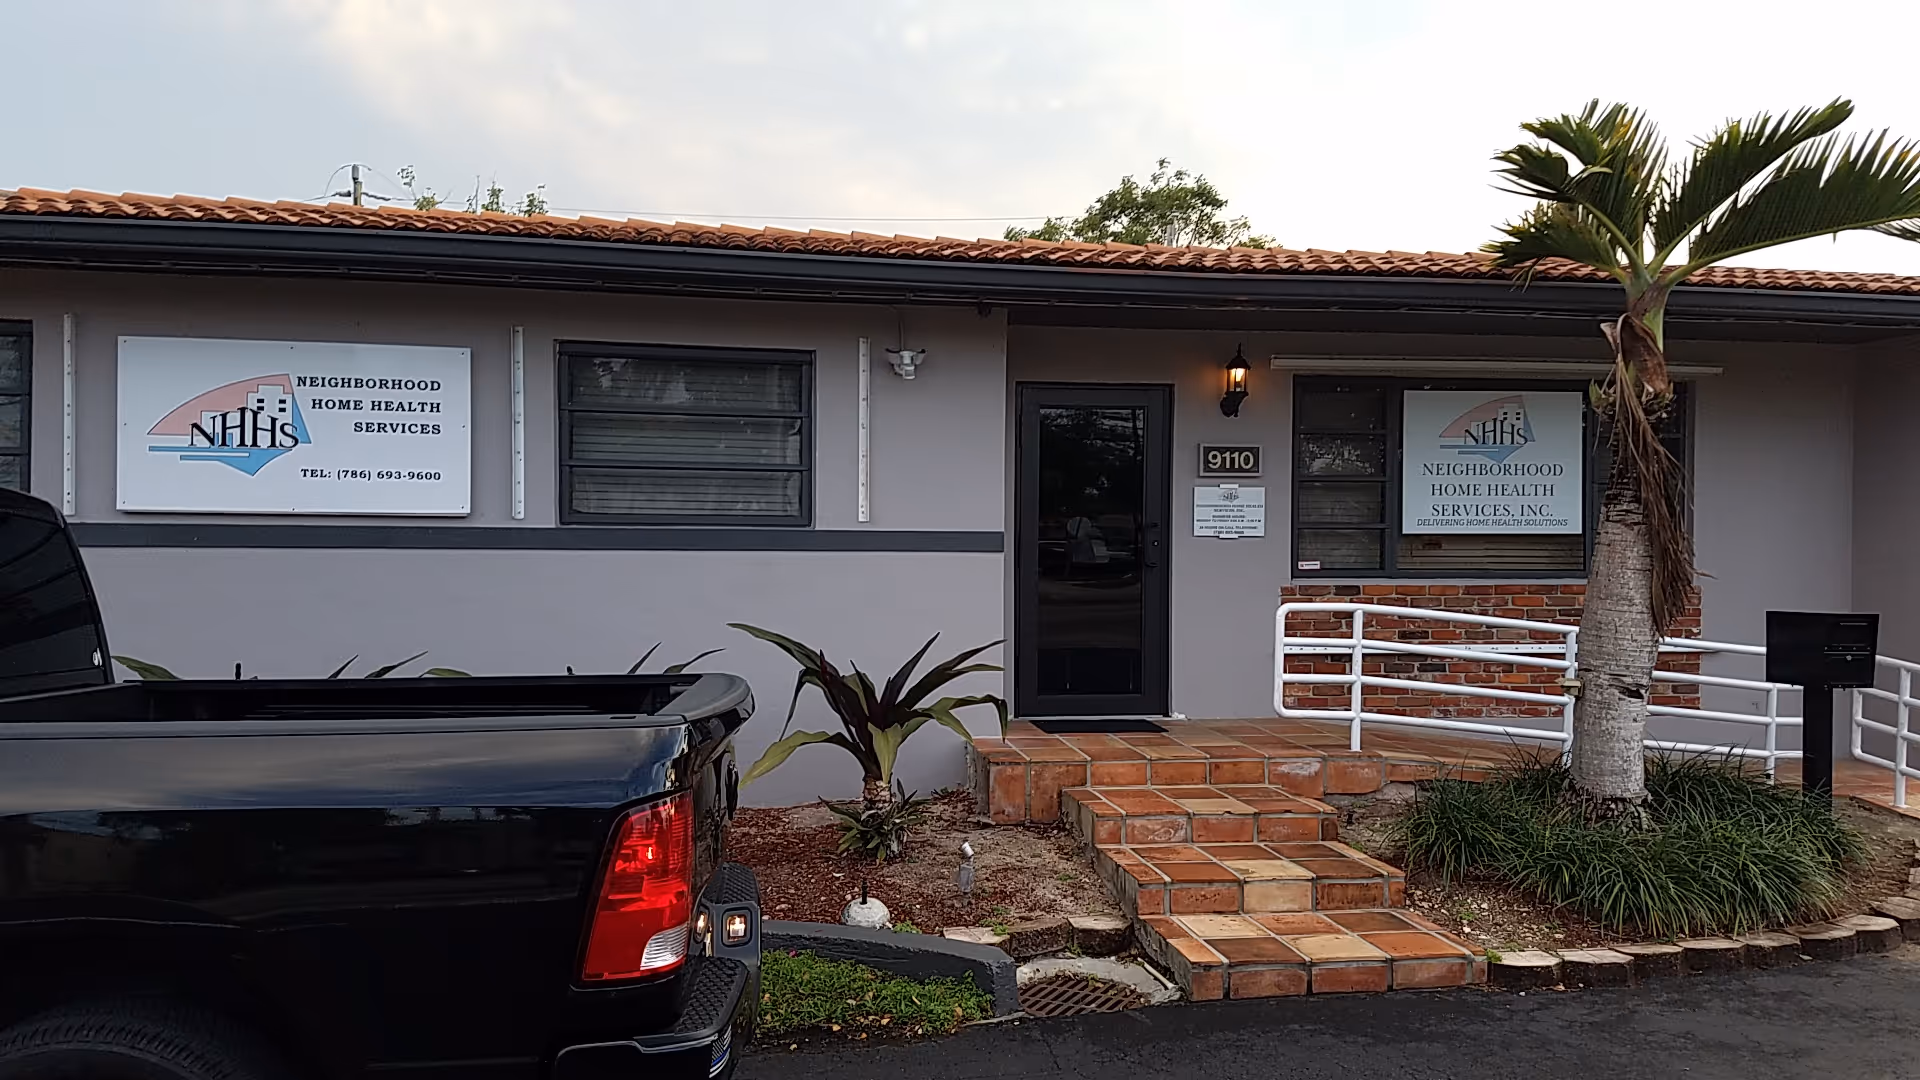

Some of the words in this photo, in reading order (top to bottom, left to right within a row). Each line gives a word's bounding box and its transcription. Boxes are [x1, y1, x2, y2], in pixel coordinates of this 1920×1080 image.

[296, 376, 442, 392] NEIGHBORHOOD
[311, 399, 364, 411] HOME
[370, 400, 442, 413] HEALTH
[188, 407, 299, 449] NHHS
[353, 421, 442, 435] SERVICES
[1464, 417, 1529, 446] NHHS
[1207, 450, 1254, 470] 9110
[300, 468, 332, 480] TEL:
[337, 469, 372, 481] (786)
[376, 471, 442, 482] 693-9600
[1422, 462, 1564, 477] NEIGHBORHOOD
[1431, 483, 1482, 497] HOME
[1487, 483, 1555, 497] HEALTH
[1431, 503, 1515, 518] SERVICES,
[1520, 504, 1554, 517] INC.
[1416, 518, 1465, 527] DELIVERING
[1466, 518, 1491, 527] HOME
[1491, 518, 1523, 527] HEALTH
[1523, 518, 1568, 527] SOLUTIONS
